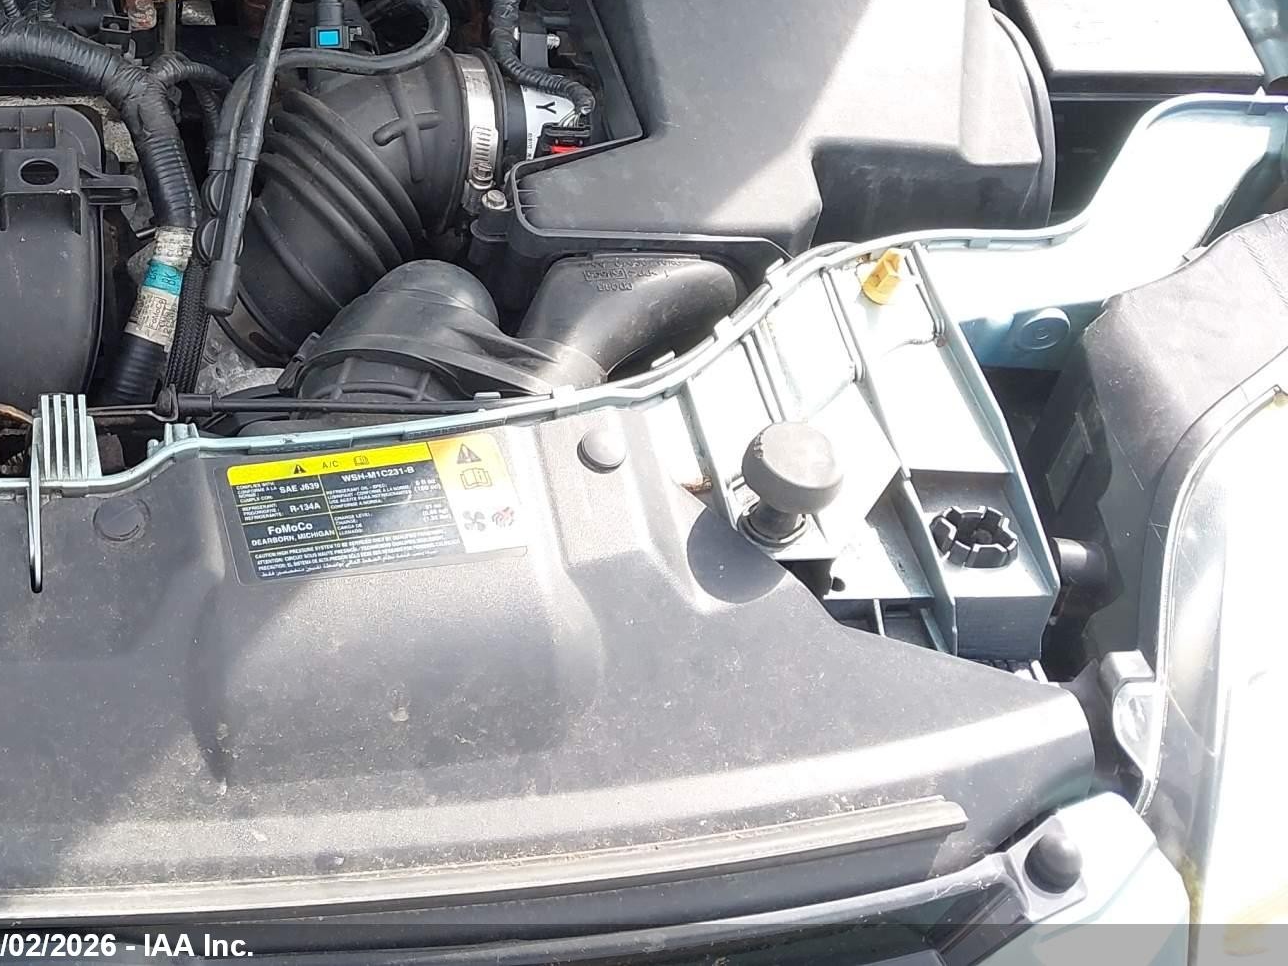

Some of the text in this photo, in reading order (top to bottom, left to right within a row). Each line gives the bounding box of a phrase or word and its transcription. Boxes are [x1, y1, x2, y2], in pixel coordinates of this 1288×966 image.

[322, 460, 339, 469] A/C
[341, 466, 415, 482] WSH-M1C231-B
[278, 482, 320, 494] SAE J639
[289, 502, 322, 512] R-134A
[267, 522, 313, 535] FoMoCo
[251, 529, 336, 547] DEARBORN, MICHIGAN
